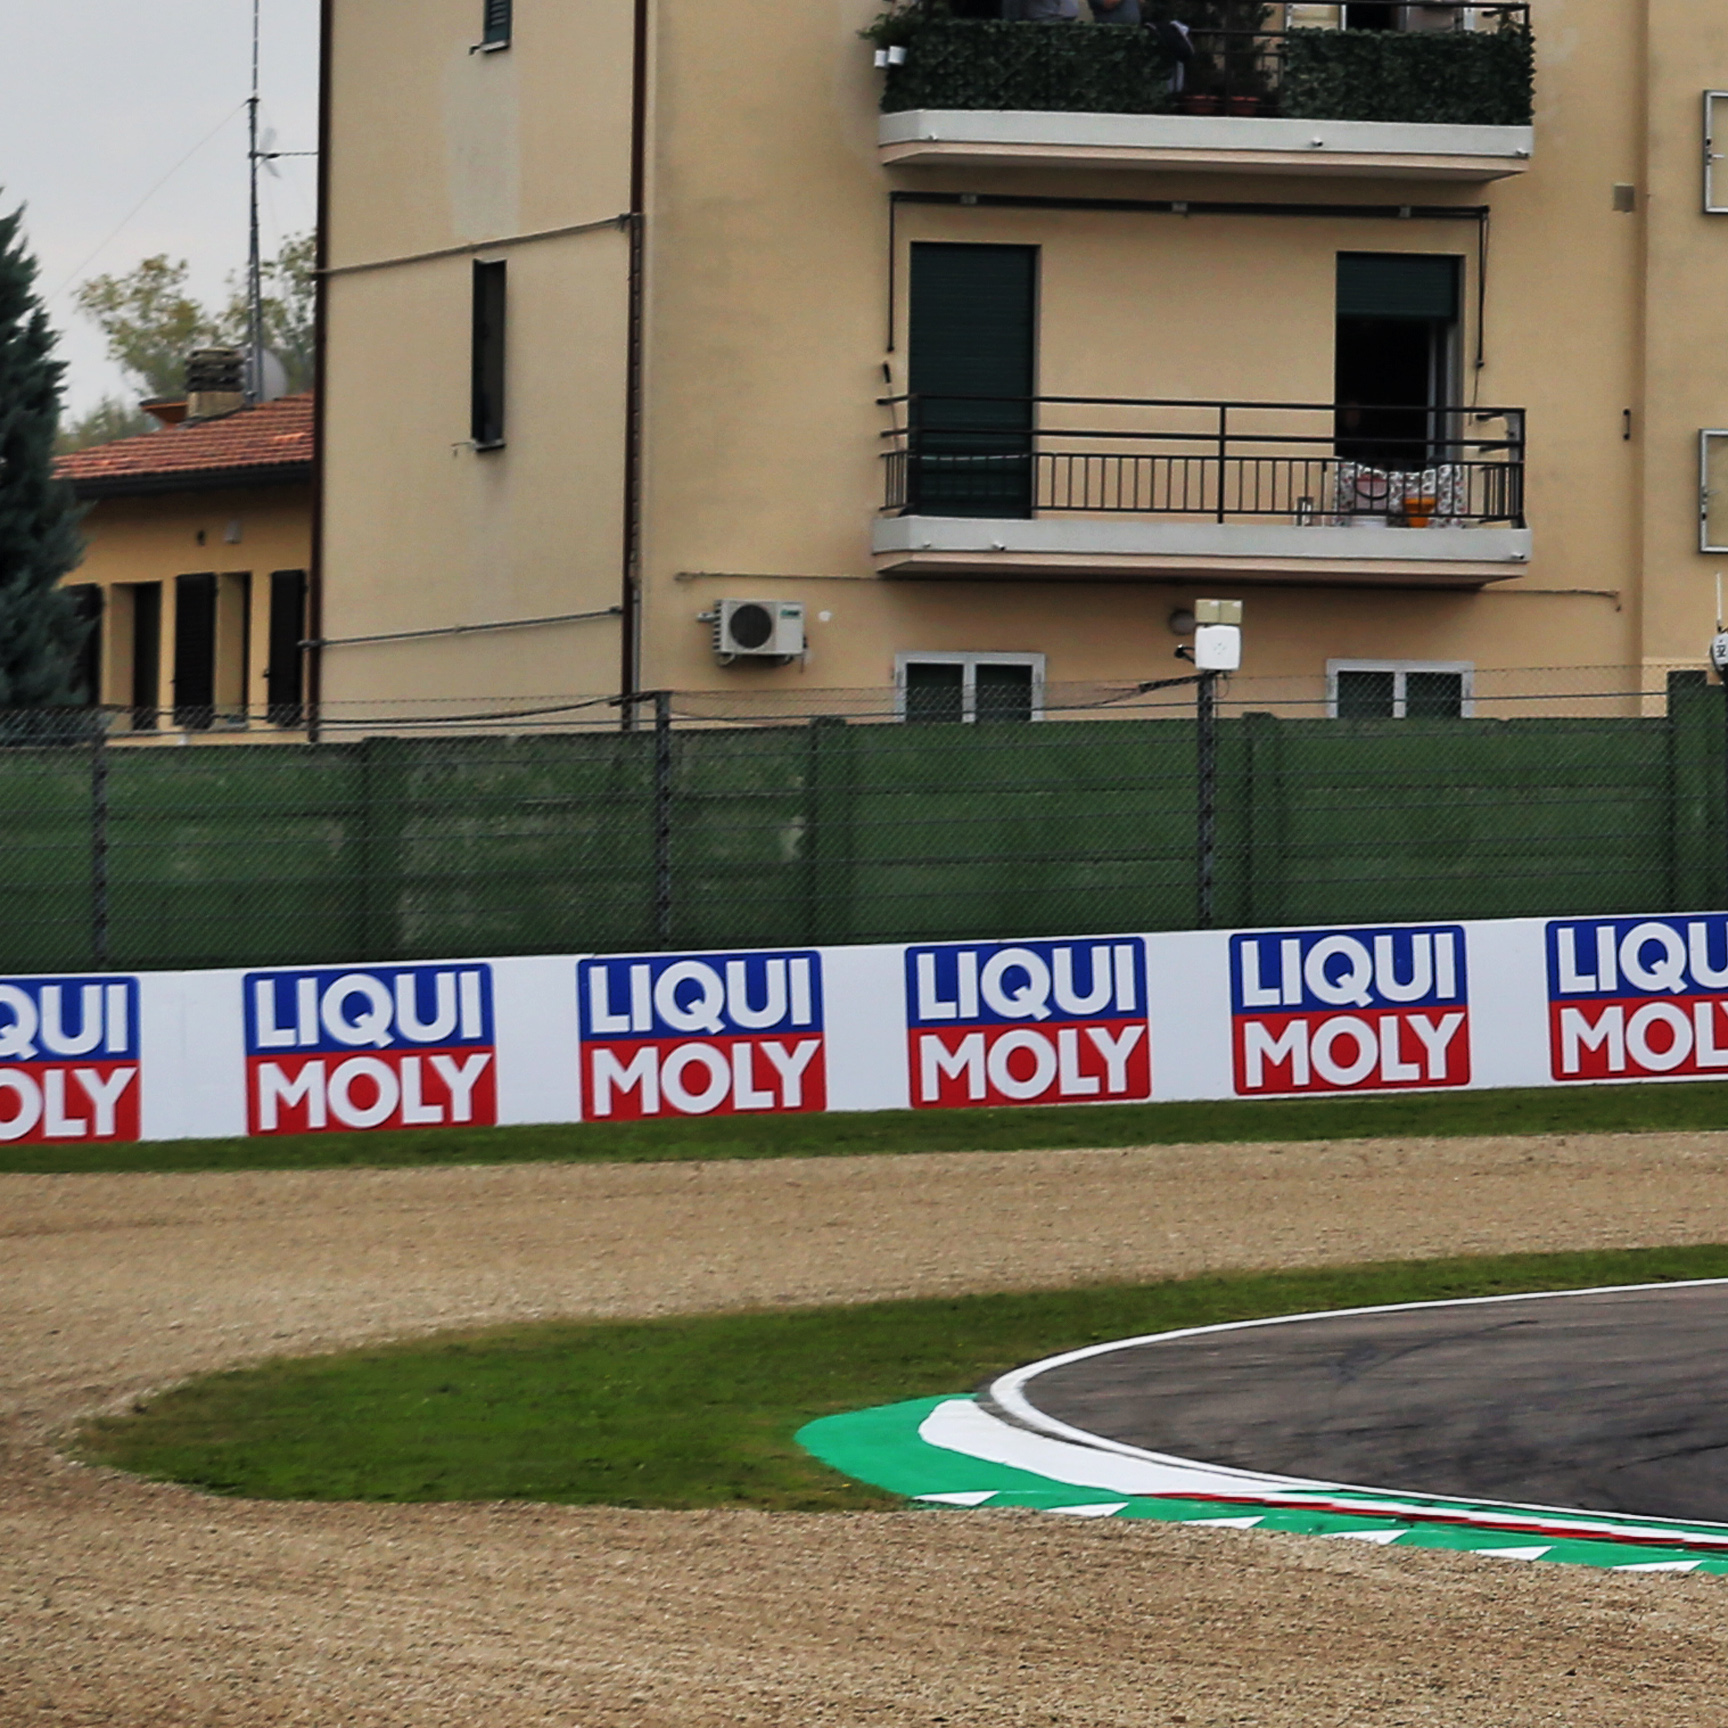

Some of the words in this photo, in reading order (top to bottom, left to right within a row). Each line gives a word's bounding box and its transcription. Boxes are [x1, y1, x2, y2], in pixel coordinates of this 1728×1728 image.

[587, 958, 812, 1036] LIQUI
[915, 944, 1136, 1022] LIQUI
[1240, 933, 1456, 1008] LIQUI
[253, 971, 483, 1050] LIQUI
[591, 1041, 821, 1116] MOLY
[920, 1027, 1145, 1102] MOLY
[1244, 1014, 1465, 1088] MOLY
[257, 1054, 491, 1129] MOLY
